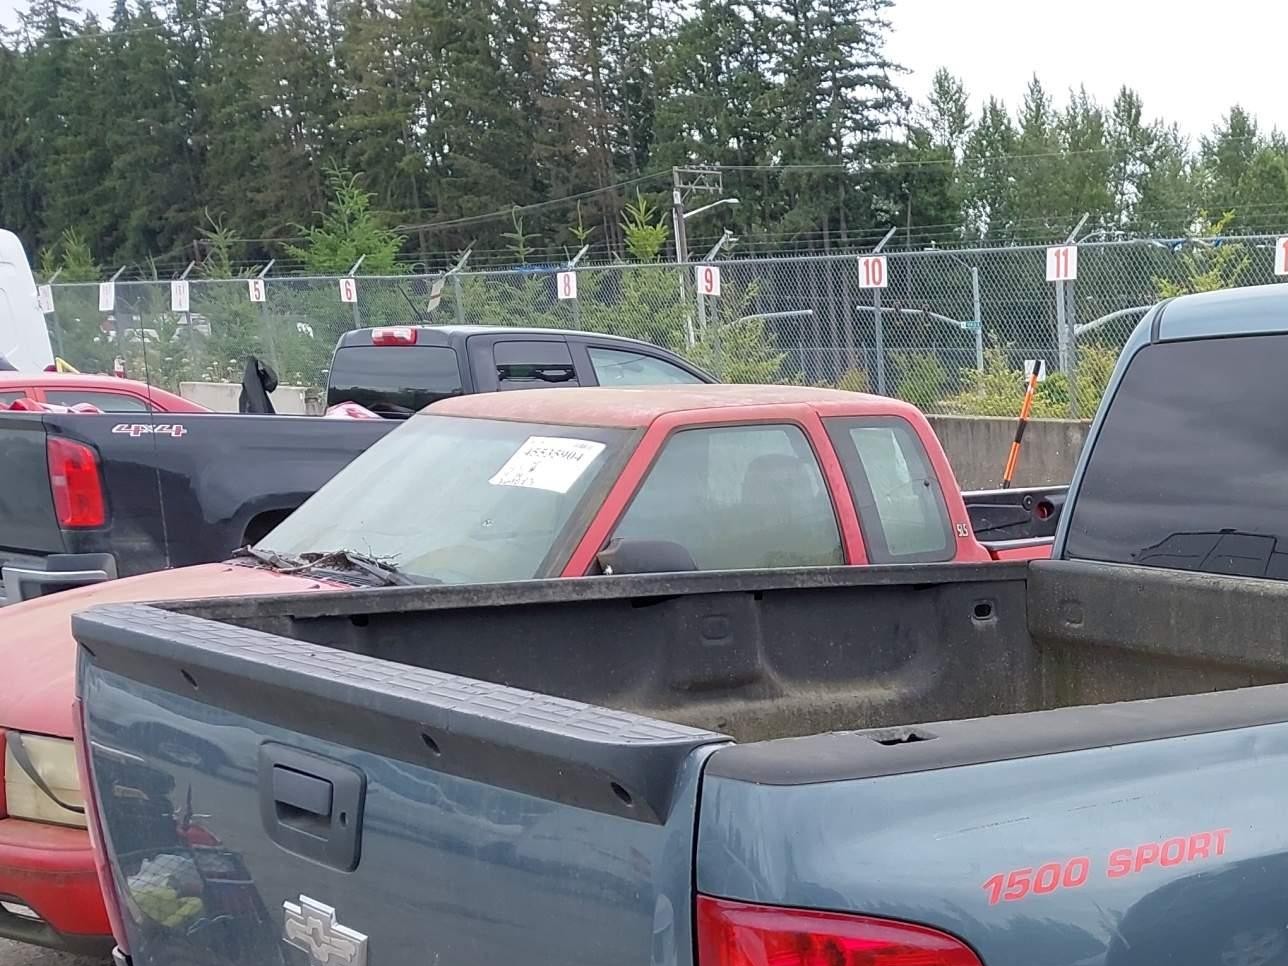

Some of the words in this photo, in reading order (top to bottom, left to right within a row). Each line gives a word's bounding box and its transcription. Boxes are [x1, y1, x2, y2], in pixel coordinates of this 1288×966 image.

[863, 258, 883, 286] 10
[1054, 247, 1069, 278] 11
[253, 281, 261, 300] 5
[344, 280, 353, 300] 6
[563, 273, 572, 297] 8
[704, 267, 714, 293] 9
[981, 856, 1091, 905] 1500
[1106, 827, 1232, 879] SPORT
